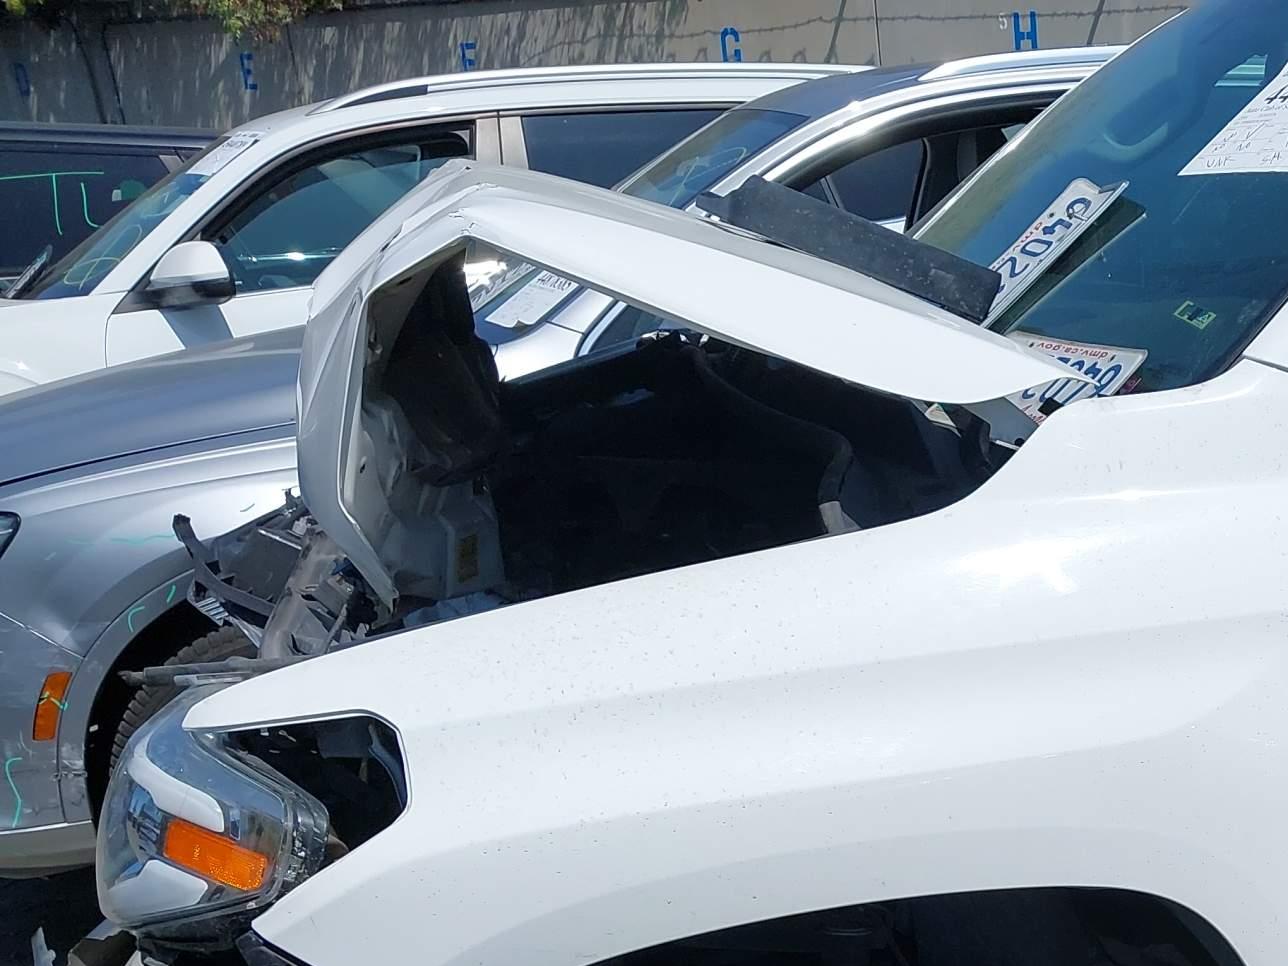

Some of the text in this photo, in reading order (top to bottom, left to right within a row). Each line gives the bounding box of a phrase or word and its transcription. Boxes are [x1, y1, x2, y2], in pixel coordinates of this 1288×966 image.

[1012, 11, 1038, 50] H
[239, 52, 258, 90] E
[1037, 341, 1109, 359] dmv.ca.gov
